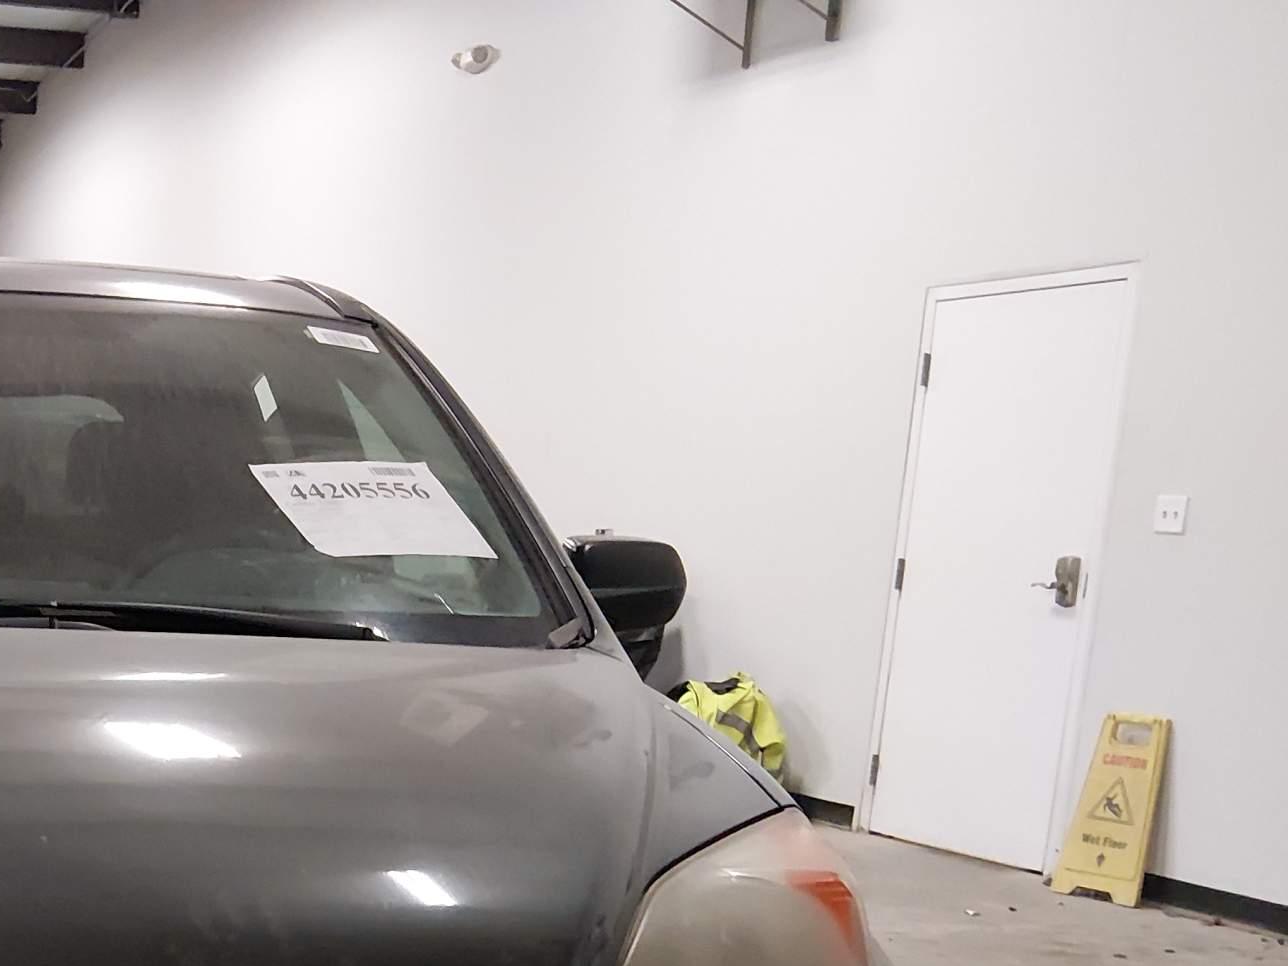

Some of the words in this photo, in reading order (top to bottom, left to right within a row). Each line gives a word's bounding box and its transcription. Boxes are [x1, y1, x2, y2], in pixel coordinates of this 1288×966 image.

[290, 482, 431, 500] 44205556
[1103, 753, 1148, 770] CAUTION
[1082, 832, 1101, 846] Wet
[1102, 836, 1128, 850] Floor
